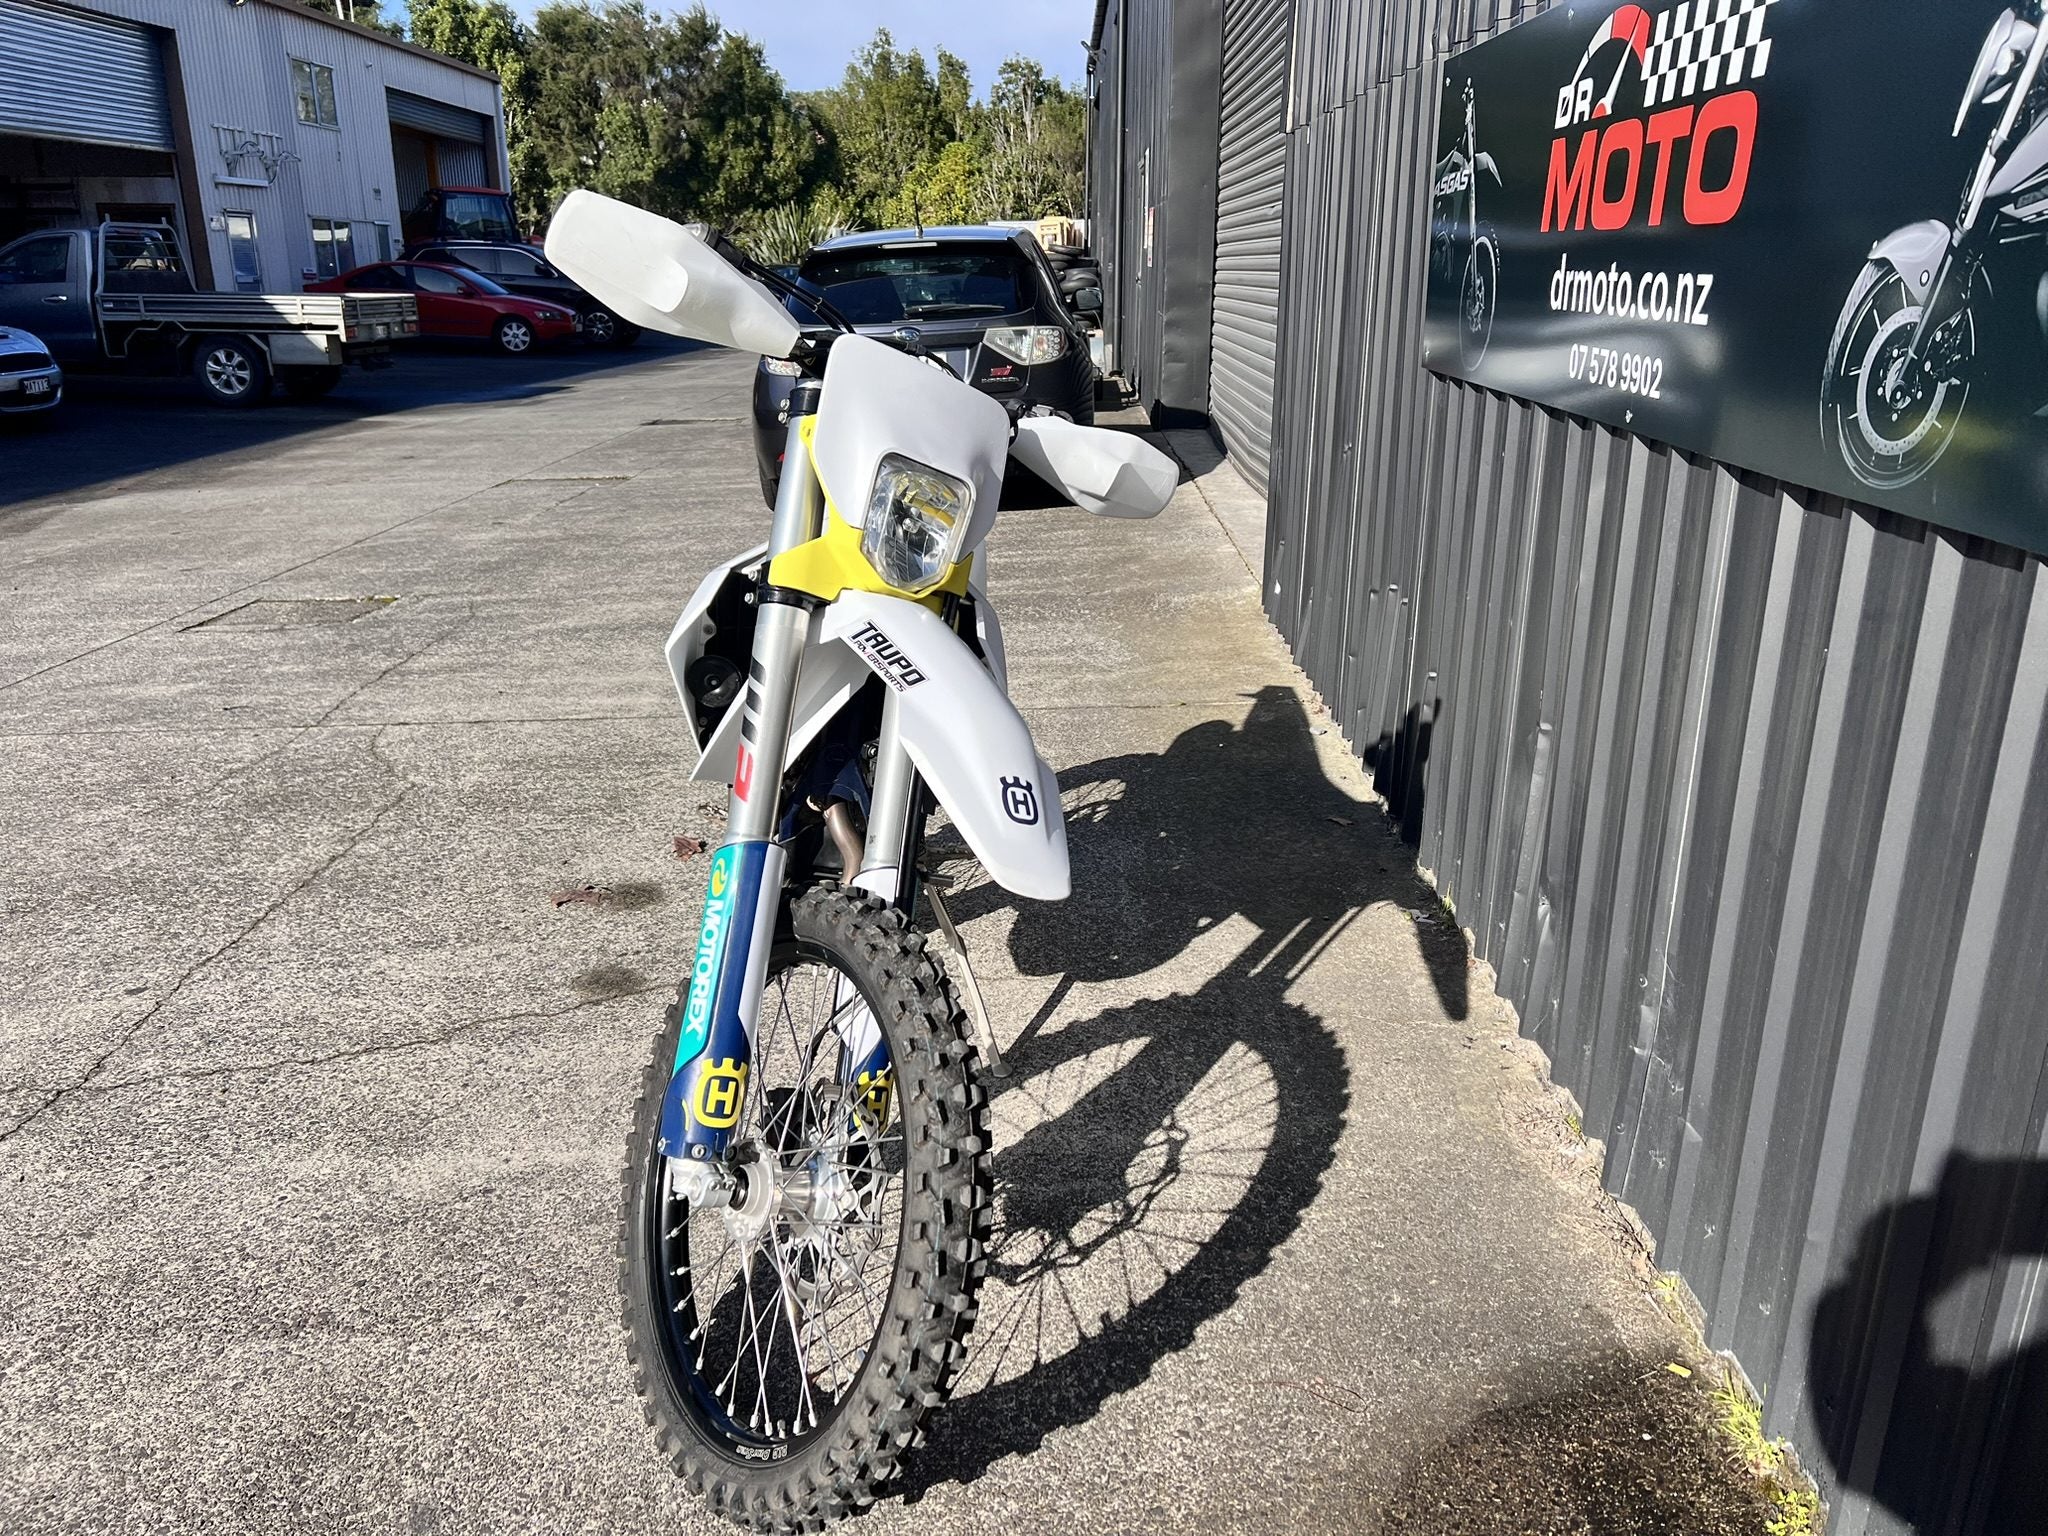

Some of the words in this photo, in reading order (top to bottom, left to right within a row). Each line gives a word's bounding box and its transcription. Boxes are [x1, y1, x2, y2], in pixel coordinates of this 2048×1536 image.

[1540, 90, 1758, 233] MOTO
[1550, 253, 1713, 325] drmoto.co.nz
[1569, 343, 1588, 380] 07
[1589, 347, 1618, 388] 578
[1620, 352, 1662, 399] 9902
[851, 622, 926, 686] TAUPO
[685, 899, 724, 1040] MOTOREX
